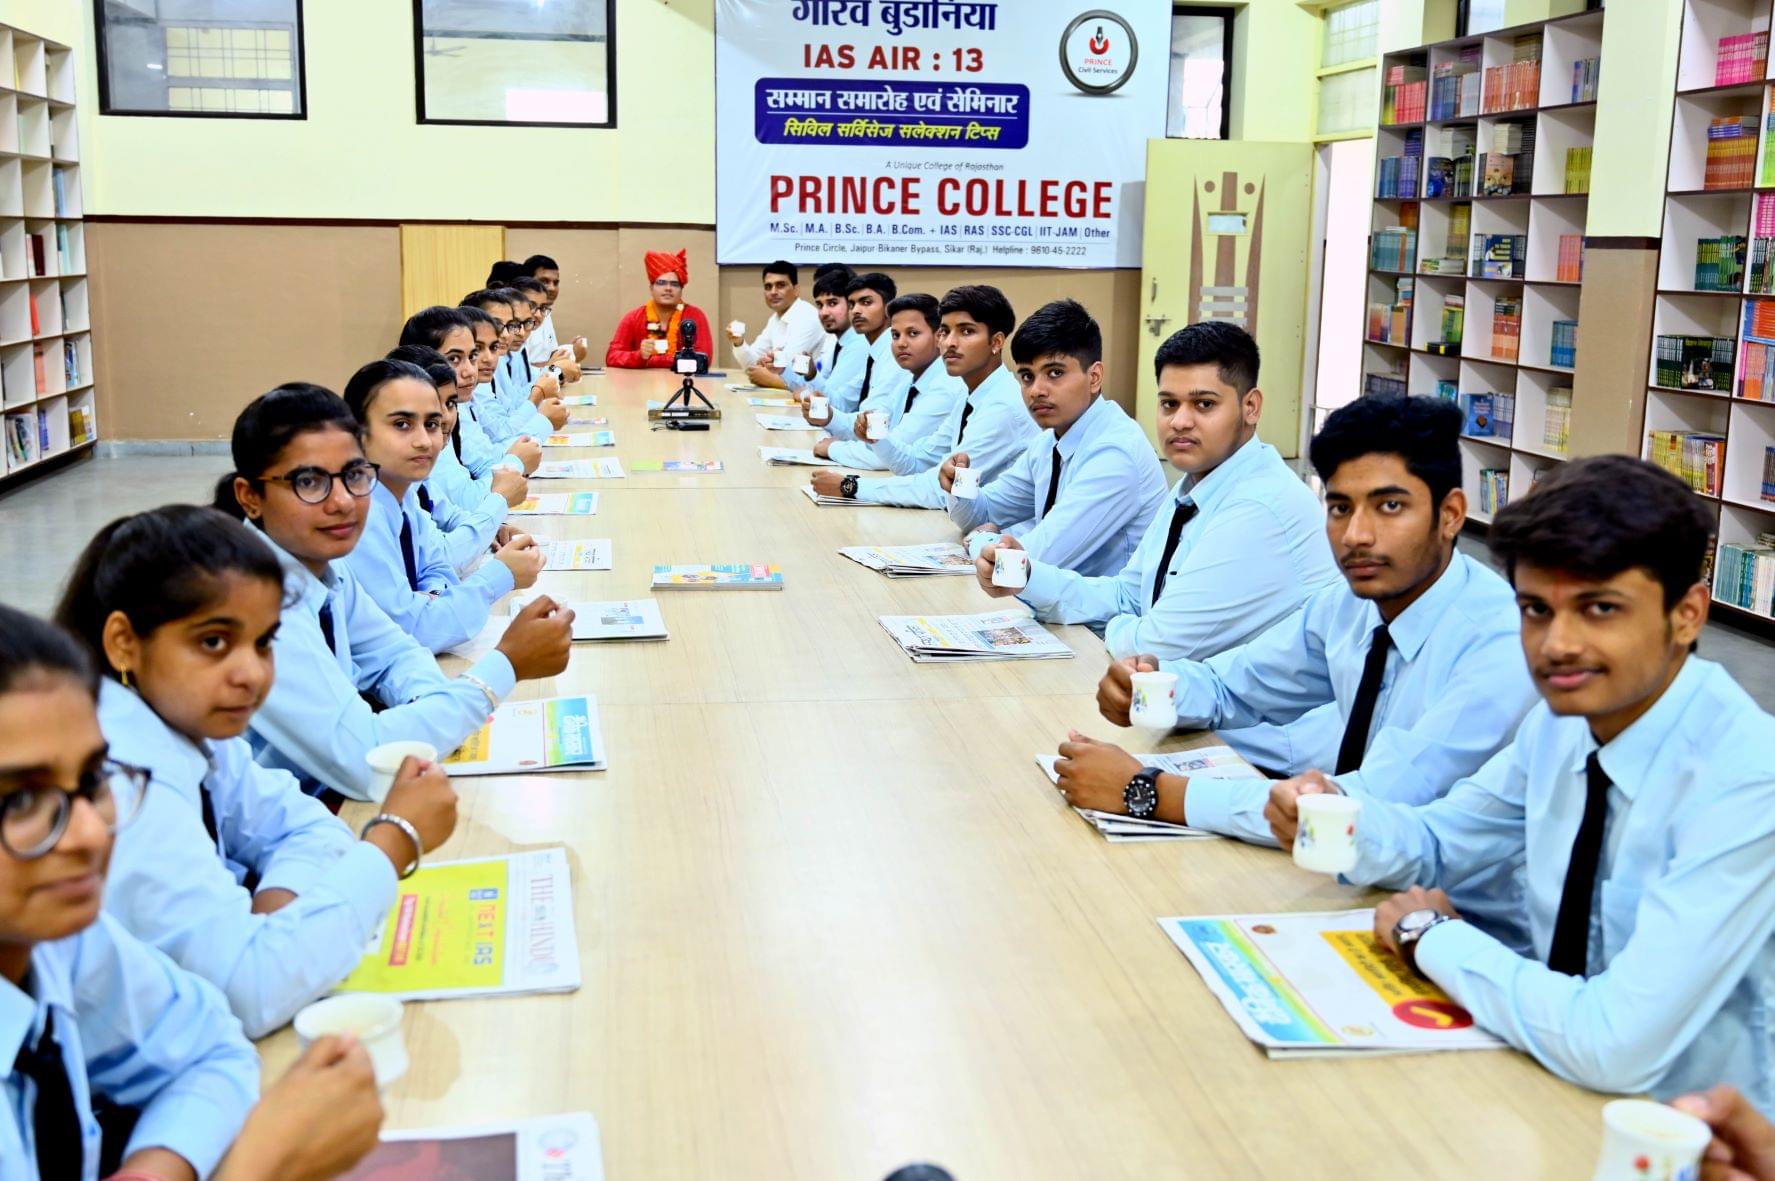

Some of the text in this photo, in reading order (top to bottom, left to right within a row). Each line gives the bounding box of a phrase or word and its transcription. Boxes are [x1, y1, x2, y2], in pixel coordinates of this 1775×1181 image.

[804, 43, 856, 69] IAS
[867, 45, 921, 70] AIR
[952, 47, 984, 72] 13
[1084, 58, 1112, 66] PRINCE
[765, 85, 1020, 113] सम्मान समारोह एवं सेमिनार
[783, 117, 1002, 141] सिविल सर्विसेज सलेक्शन टिप्स
[893, 161, 922, 171] Unique
[924, 161, 953, 172] College
[955, 162, 965, 172] of
[965, 162, 1005, 172] Rajasthan
[770, 175, 1113, 219] PRINCE COLLEGE
[770, 222, 799, 234] M.Sc.
[805, 223, 828, 234] M.A.
[835, 223, 861, 234] B.Sc.
[866, 223, 886, 235] B.A.
[892, 224, 926, 235] B.Com.
[940, 225, 957, 236] IAS
[964, 225, 985, 236] RAS
[1084, 227, 1111, 238] Other
[795, 242, 820, 252] Prince
[823, 243, 848, 253] Circle,
[850, 243, 875, 254] Jaipur
[878, 243, 908, 253] Bikaner
[945, 244, 964, 254] Sikar
[993, 245, 1024, 256] Helpline
